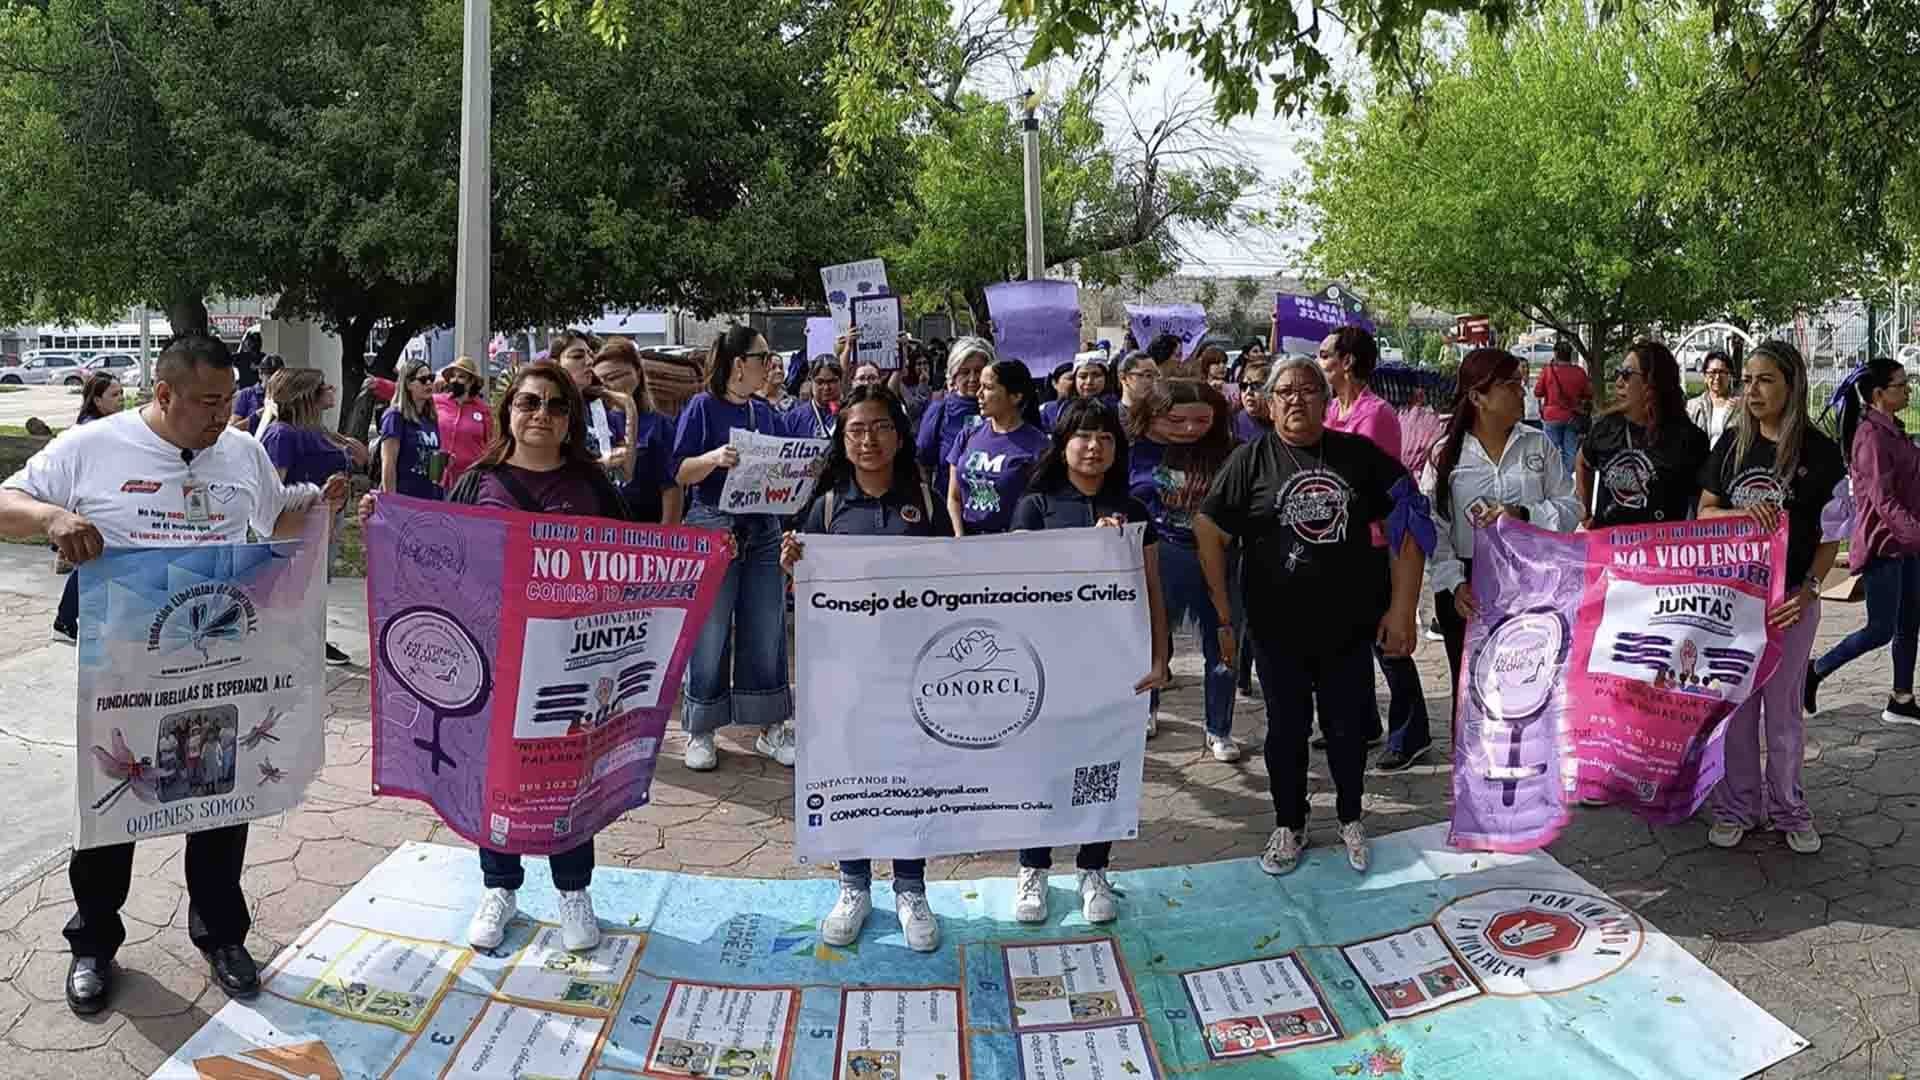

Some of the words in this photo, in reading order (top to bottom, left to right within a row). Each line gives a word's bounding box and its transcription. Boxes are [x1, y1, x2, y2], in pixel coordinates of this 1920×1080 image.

[532, 546, 571, 580] NO
[580, 549, 706, 584] VIOLENCIA
[1613, 546, 1648, 567] NO
[1655, 541, 1771, 568] VIOLENCIA
[1696, 561, 1770, 588] MUJER
[621, 582, 699, 602] MUJER
[810, 590, 890, 616] Consejo
[892, 589, 918, 610] de
[920, 585, 1074, 612] Organizaciones
[1076, 583, 1138, 603] Civiles
[1655, 583, 1738, 600] CAMINEMOS
[1654, 595, 1734, 622] JUNTAS
[570, 621, 648, 654] JUNTAS
[97, 691, 152, 712] FUNDACION
[202, 682, 214, 700] DE
[216, 675, 269, 699] ESPERANZA
[921, 677, 1020, 698] CONORCI
[805, 776, 889, 792] CONTACTANOS
[199, 794, 256, 819] SOMOS
[830, 806, 926, 823] CONORCI-Consejo
[926, 805, 938, 816] de
[939, 801, 1020, 816] Organizaciones
[1020, 801, 1054, 812] Civiles
[1528, 892, 1575, 909] PON
[1575, 902, 1608, 918] UN
[1456, 917, 1482, 930] LA
[1456, 933, 1527, 979] VIOLENCIA
[430, 1031, 455, 1046] 3
[809, 1027, 833, 1040] 5
